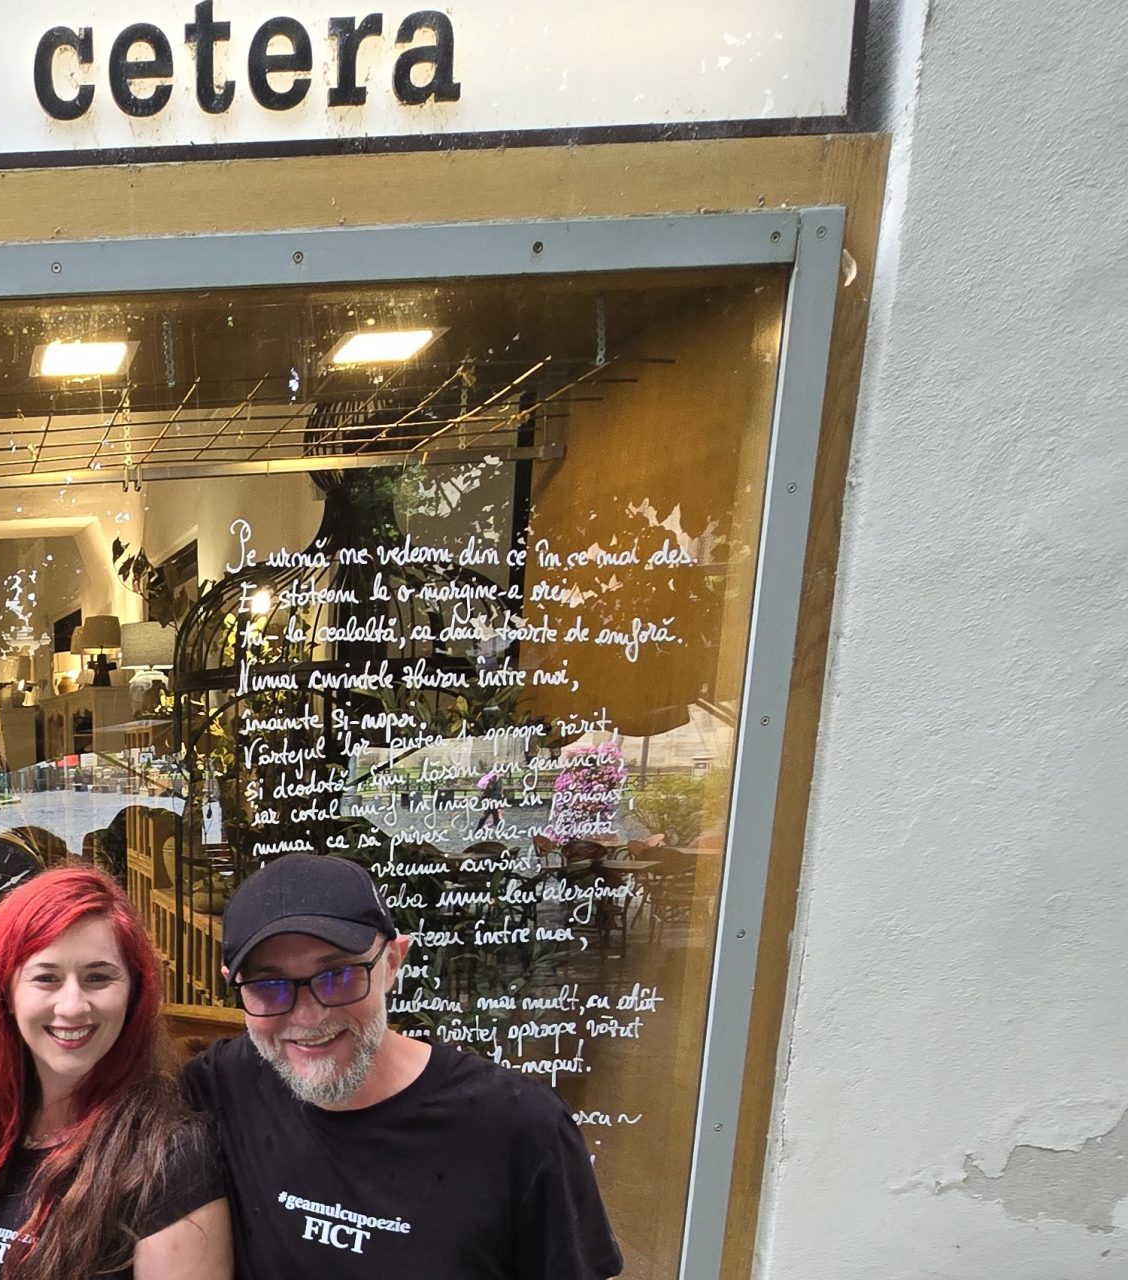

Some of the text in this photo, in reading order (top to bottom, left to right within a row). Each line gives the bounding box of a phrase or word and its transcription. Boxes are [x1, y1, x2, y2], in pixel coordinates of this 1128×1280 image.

[32, 0, 462, 121] cetera
[226, 518, 257, 574] Pe
[265, 537, 330, 568] urmă
[340, 547, 371, 566] ne
[377, 533, 453, 566] vedeam
[458, 535, 500, 566] din
[506, 548, 526, 567] ce
[567, 550, 588, 568] ce
[596, 540, 640, 567] mai
[238, 581, 272, 614] E
[370, 572, 392, 601] la
[397, 586, 416, 603] o
[285, 617, 307, 643] la
[316, 614, 405, 649] cealaltă,
[409, 625, 436, 641] ca
[439, 611, 489, 642] două
[495, 610, 558, 642] toarte
[563, 615, 590, 643] de
[594, 616, 683, 663] amforă.
[236, 655, 579, 697] Numai cuvintele zburau între noi,
[239, 703, 324, 735] înainte
[244, 733, 326, 779] Vârtejul
[340, 731, 372, 757] lor
[389, 731, 445, 769] putea
[482, 723, 546, 756] aproape
[557, 707, 618, 743] zărit,
[416, 757, 480, 782] lăsam
[488, 759, 522, 774] un
[250, 804, 280, 827] iar
[252, 830, 314, 857] numai
[326, 835, 350, 849] ca
[357, 826, 381, 849] să
[390, 825, 449, 861] privesc
[371, 853, 450, 878] vreunui
[435, 881, 495, 908] unui
[499, 878, 537, 904] leu
[473, 915, 531, 946] între
[535, 917, 589, 951] noi,
[388, 987, 464, 1013] iubeam
[476, 985, 517, 1011] mai
[615, 983, 665, 1013] atât
[437, 1015, 499, 1050] vârtej
[507, 1020, 577, 1057] aproape
[277, 1190, 411, 1234] #geamulcupoezie
[301, 1214, 371, 1254] FICT
